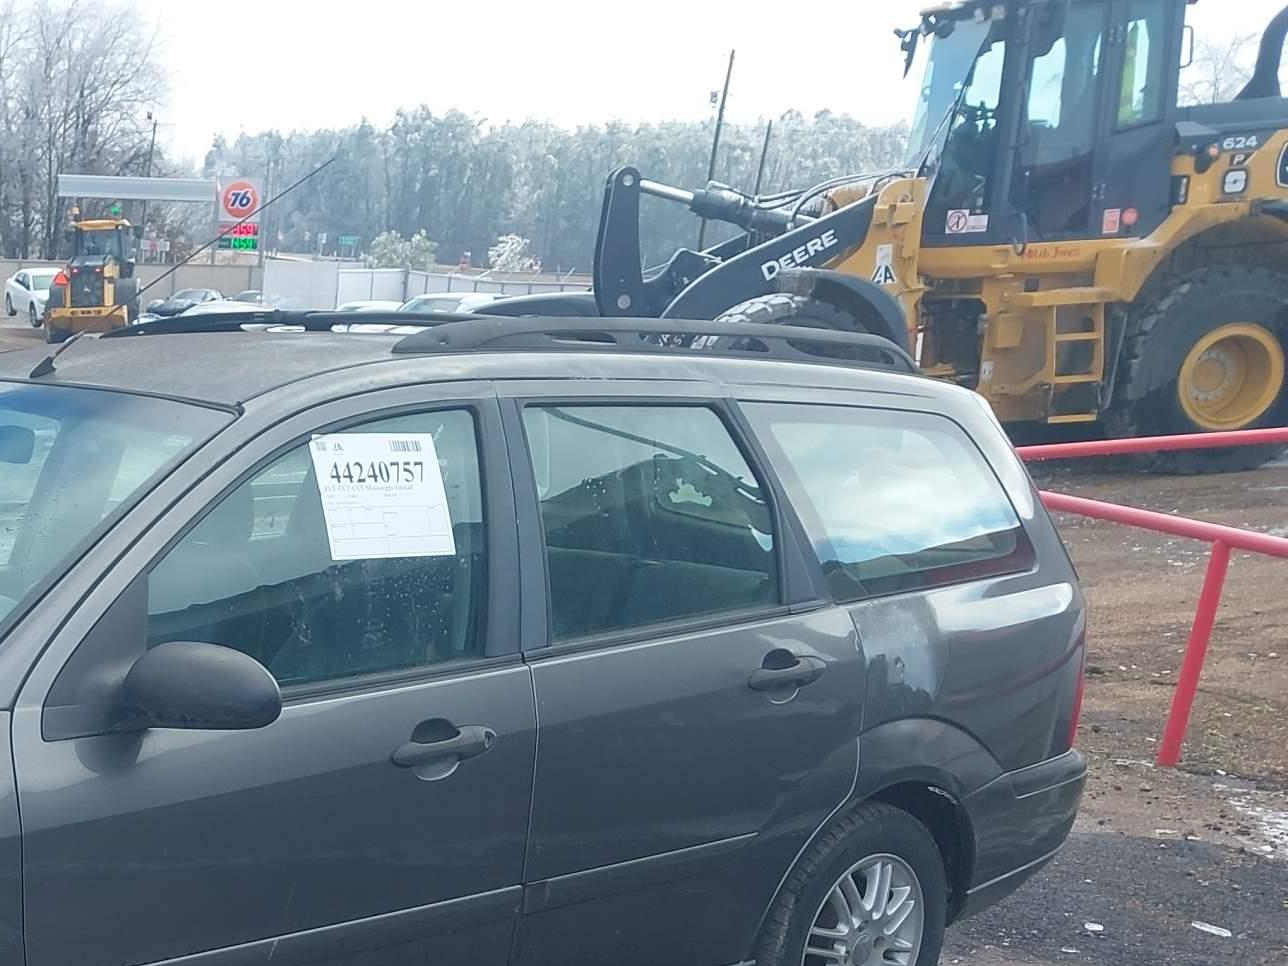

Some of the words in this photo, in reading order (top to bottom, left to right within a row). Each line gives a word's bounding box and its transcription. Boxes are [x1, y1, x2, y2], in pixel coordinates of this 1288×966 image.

[1222, 135, 1258, 150] 624
[1233, 154, 1245, 166] P
[229, 189, 252, 208] 76
[761, 229, 839, 281] DEERE
[330, 461, 423, 484] 44240757
